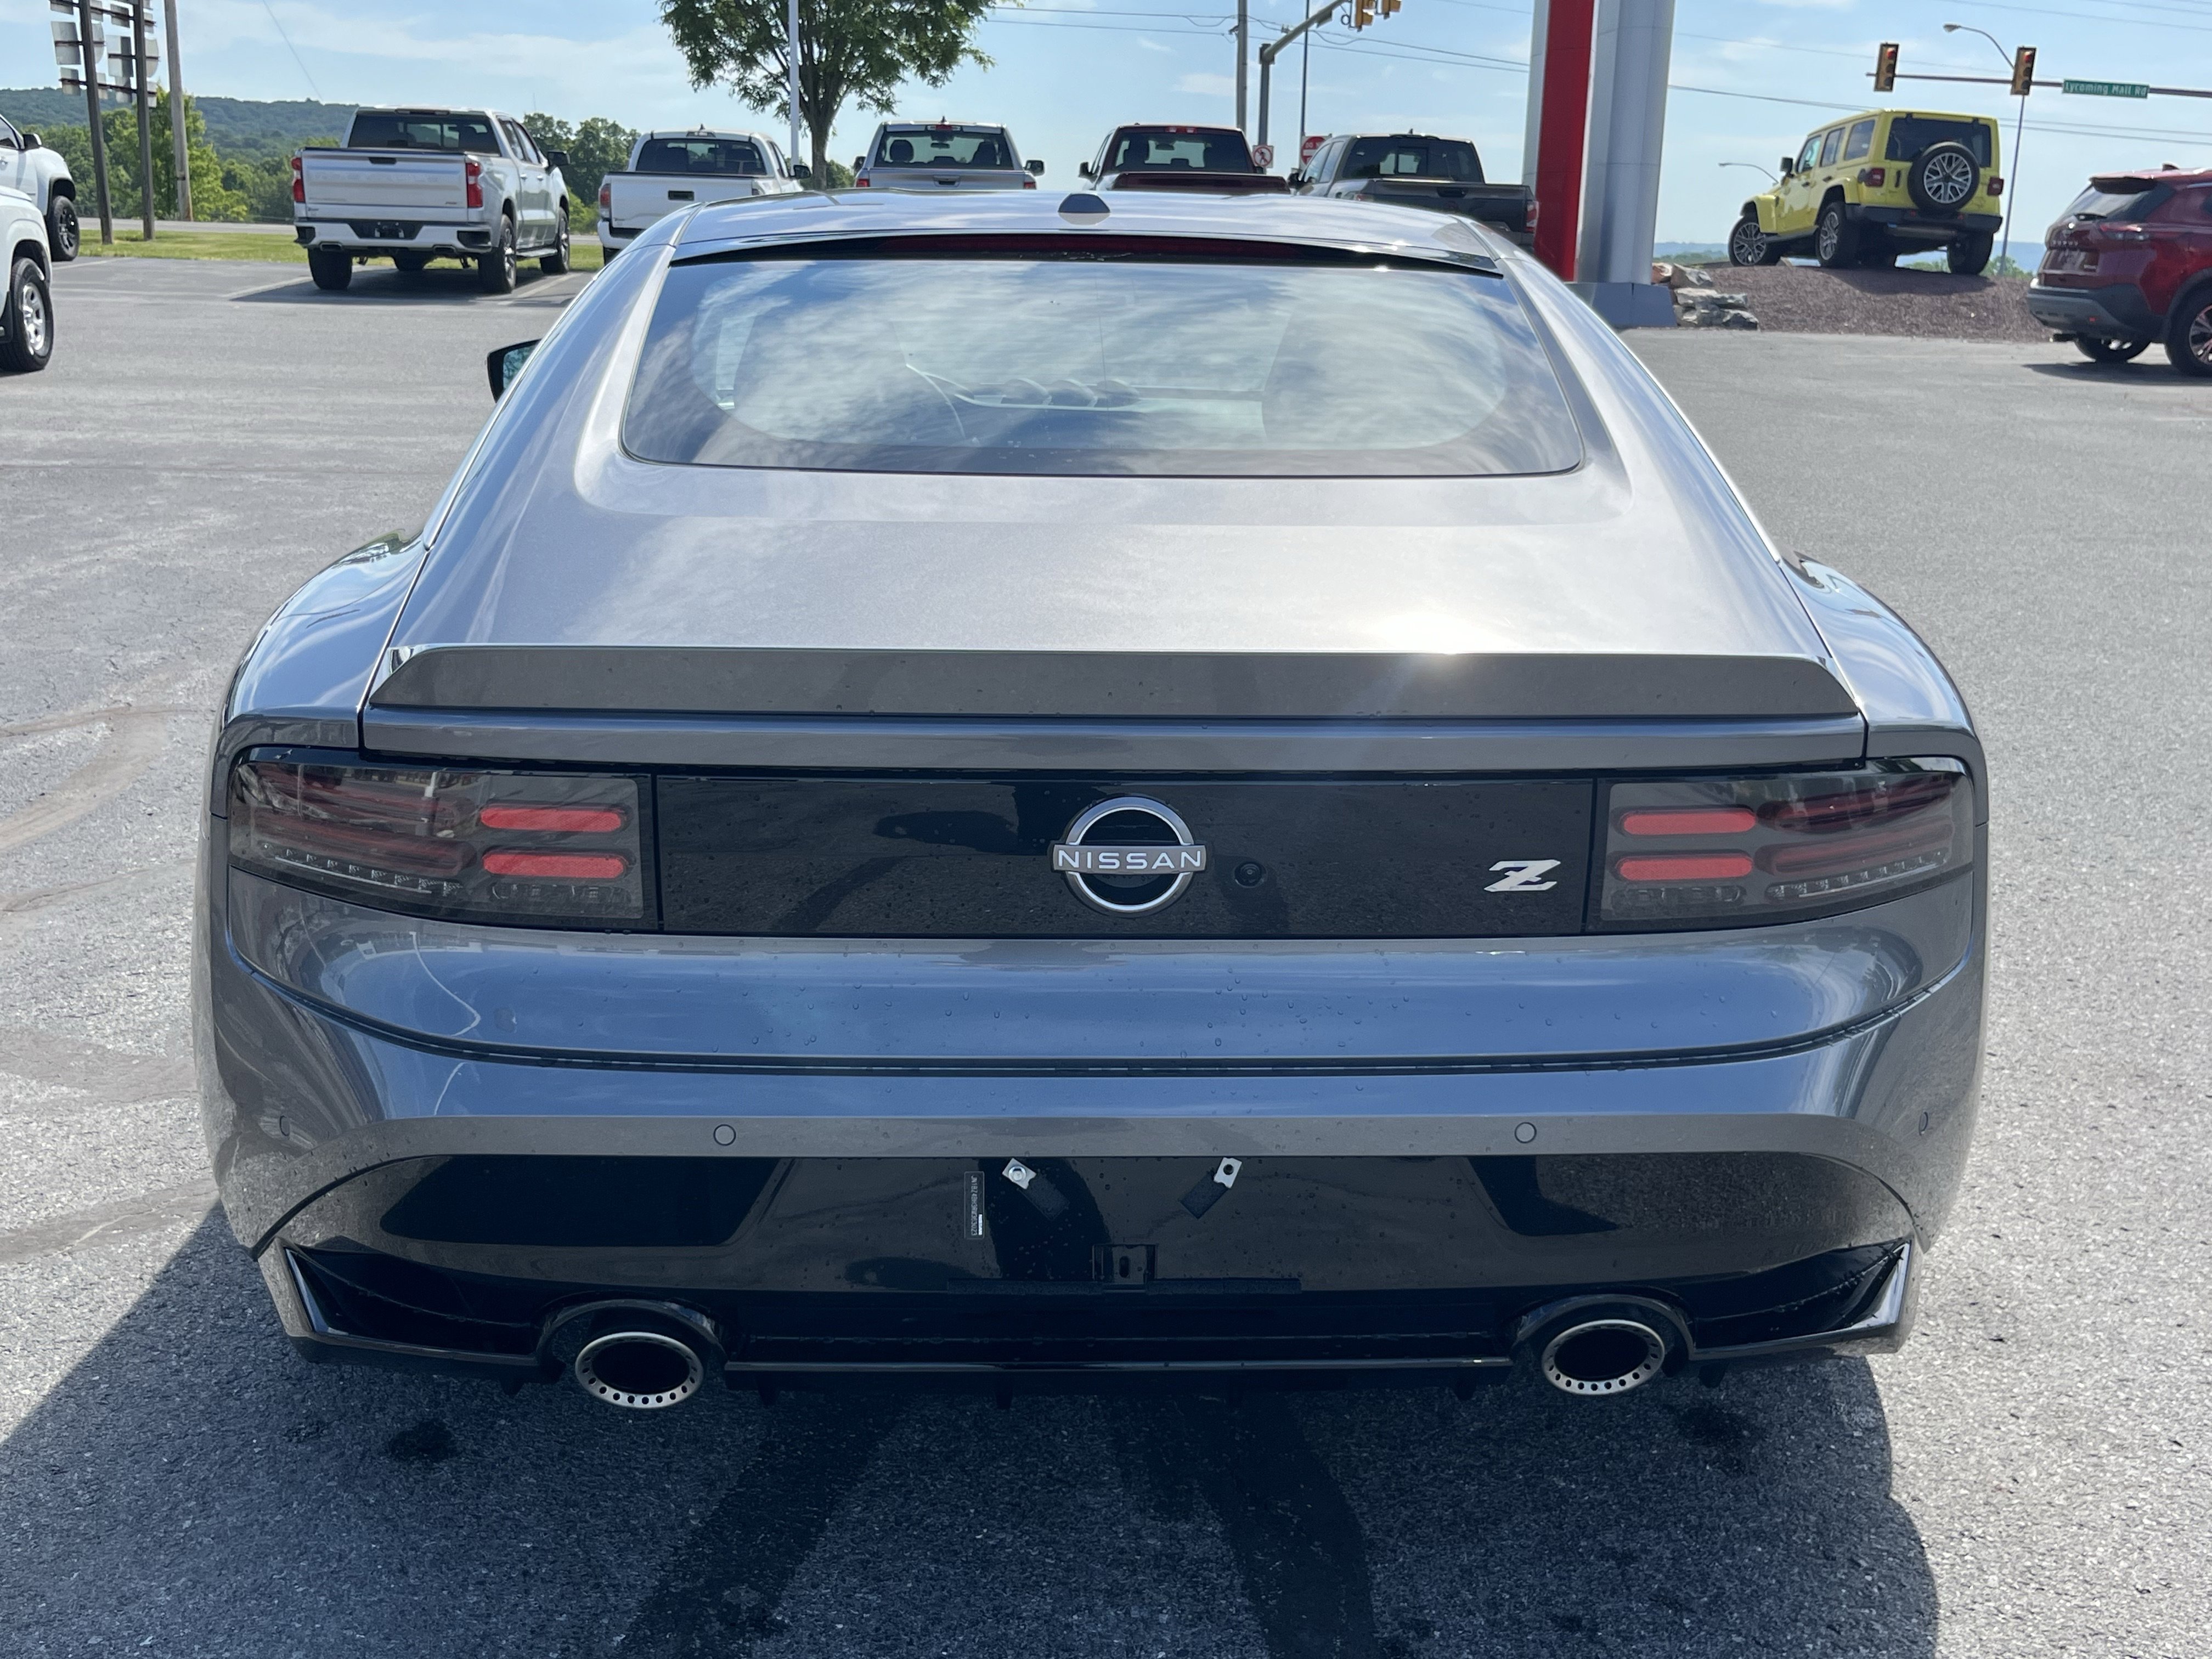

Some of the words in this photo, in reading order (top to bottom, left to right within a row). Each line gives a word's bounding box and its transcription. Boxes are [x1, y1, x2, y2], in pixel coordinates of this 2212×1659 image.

[2066, 81, 2108, 96] Lycoming
[2112, 84, 2131, 95] Mall
[2135, 86, 2147, 97] Rd
[1058, 850, 1201, 869] NISSAN
[1483, 859, 1561, 892] Z
